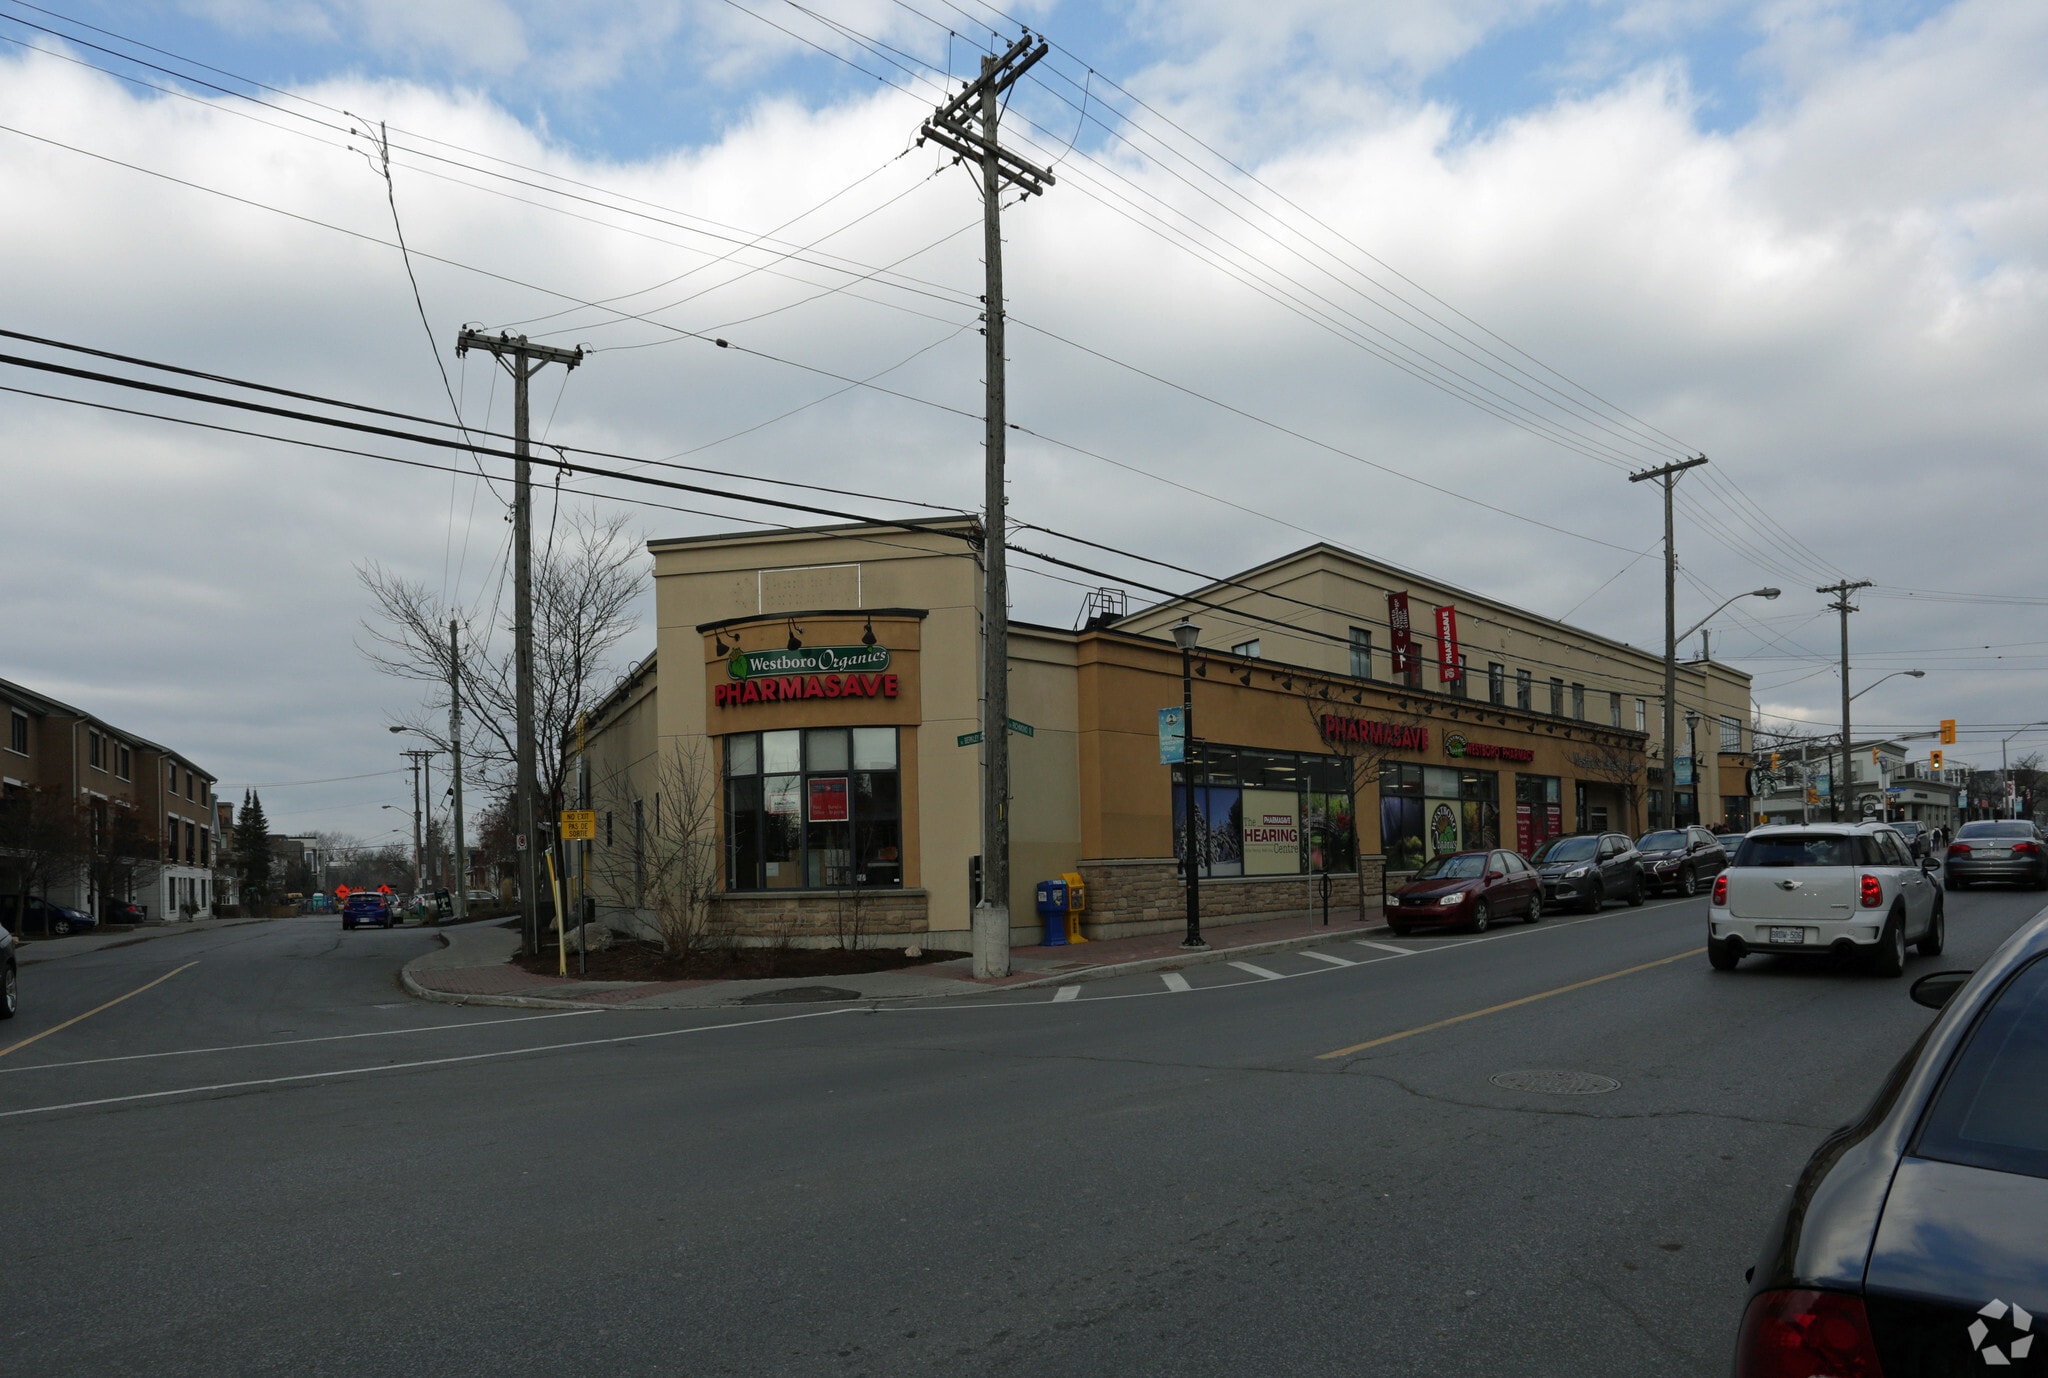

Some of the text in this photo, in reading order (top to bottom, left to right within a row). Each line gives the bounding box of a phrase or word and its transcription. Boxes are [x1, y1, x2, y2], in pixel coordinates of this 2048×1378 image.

[1442, 610, 1453, 664] PHARMASAVE
[750, 649, 887, 672] Westboro Organics
[715, 674, 899, 707] PHARMASAVE
[1325, 713, 1429, 751] PHARMASAVE
[1466, 742, 1535, 762] WESTBORO PHARMACY
[1244, 817, 1257, 828] The
[1263, 816, 1292, 825] PHARMASAVE
[1431, 805, 1457, 832] WESTBORO
[568, 830, 588, 838] SORTIE
[1244, 828, 1298, 843] HEARING
[1273, 843, 1299, 854] Centre
